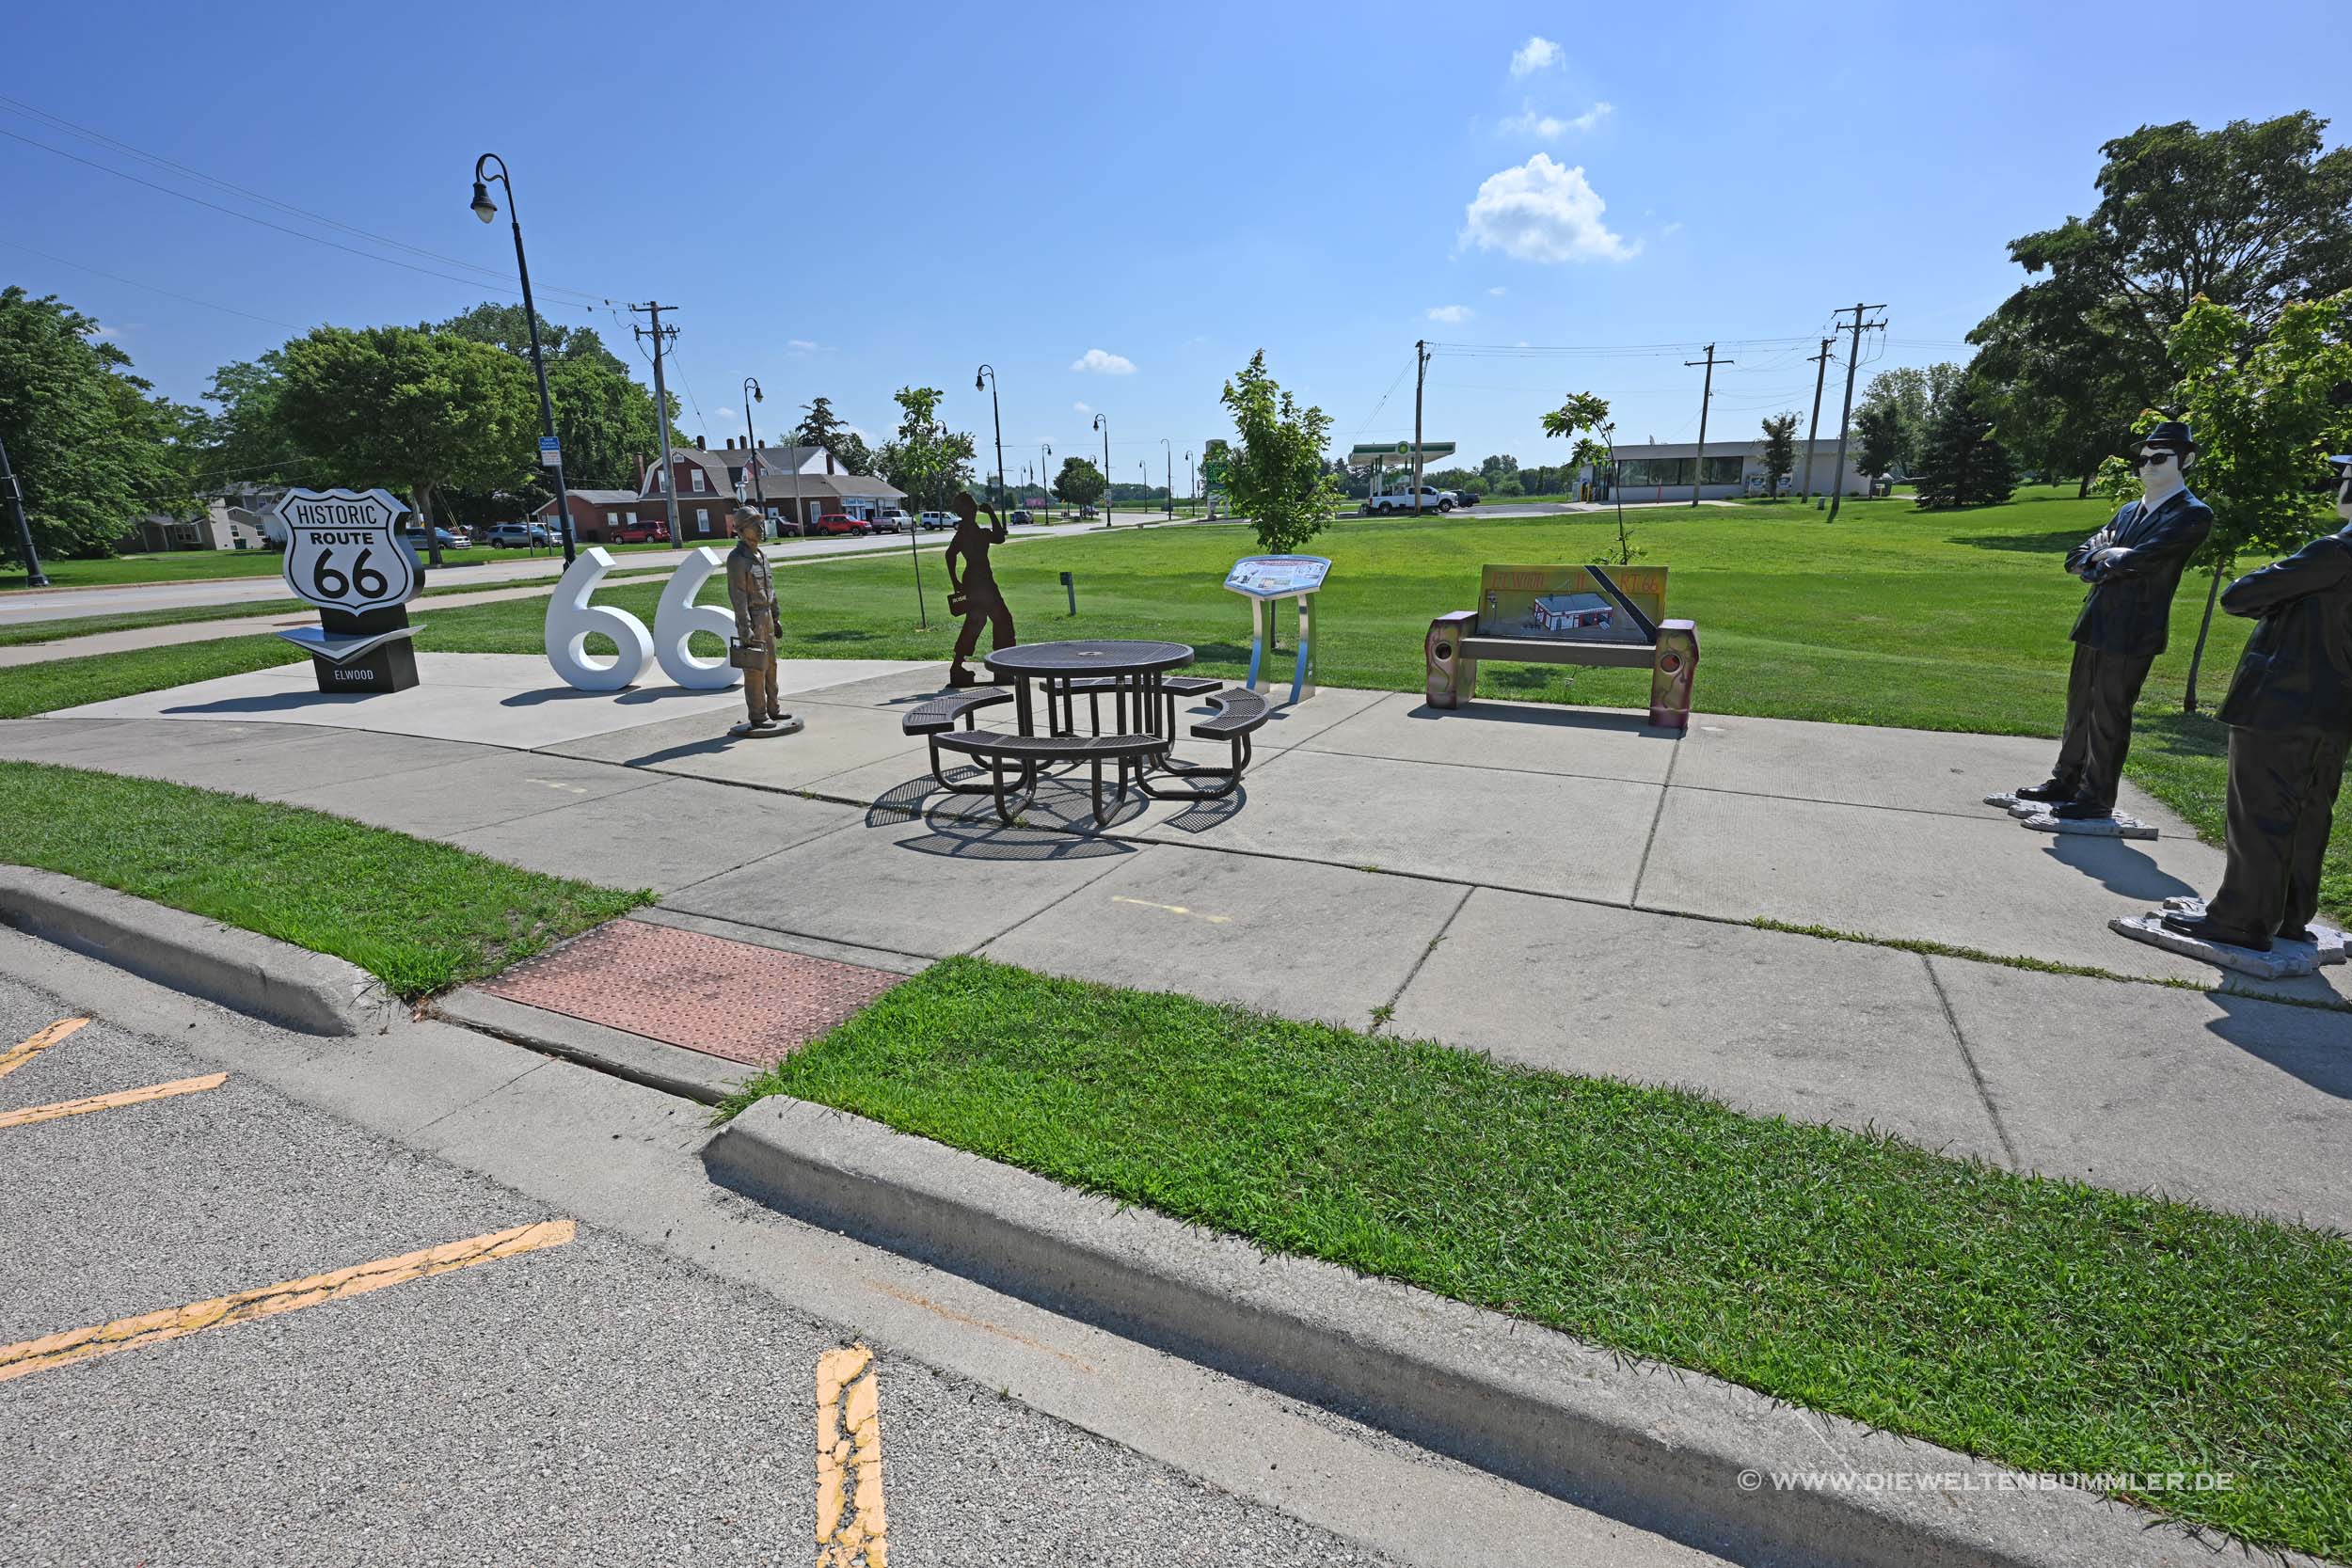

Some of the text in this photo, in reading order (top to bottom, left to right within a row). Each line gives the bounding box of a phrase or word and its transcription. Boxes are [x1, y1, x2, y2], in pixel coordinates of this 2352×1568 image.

[296, 505, 377, 525] HISTORIC
[310, 532, 374, 545] ROUTE
[313, 547, 389, 599] 66
[1620, 572, 1641, 592] RT
[1641, 574, 1660, 592] 66
[545, 546, 744, 690] 66
[334, 670, 373, 680] ELWOOD
